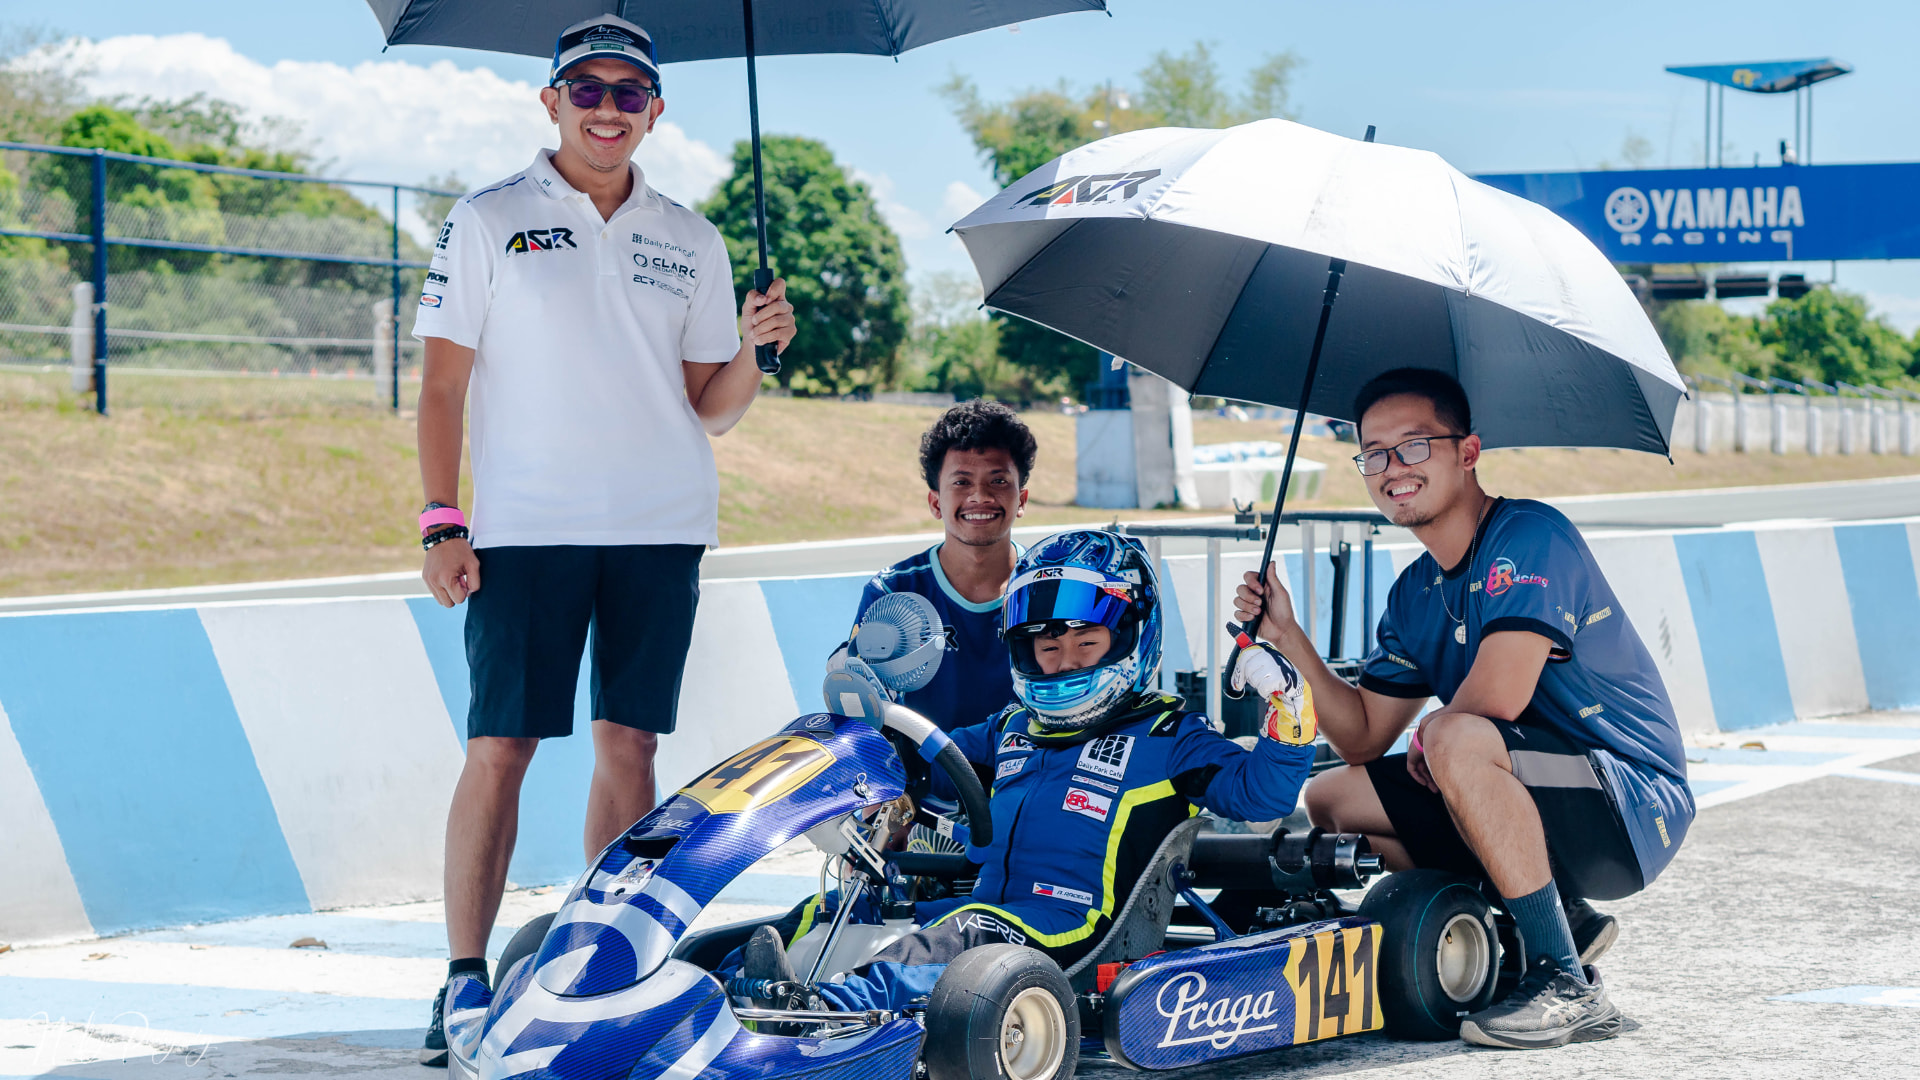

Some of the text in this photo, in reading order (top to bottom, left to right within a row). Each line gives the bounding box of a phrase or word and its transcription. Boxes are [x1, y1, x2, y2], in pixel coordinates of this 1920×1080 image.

[1650, 186, 1804, 229] YAMAHA
[1078, 760, 1093, 770] Daily
[1093, 765, 1108, 775] Park
[1155, 971, 1279, 1049] Praga
[1298, 925, 1376, 1041] 141
